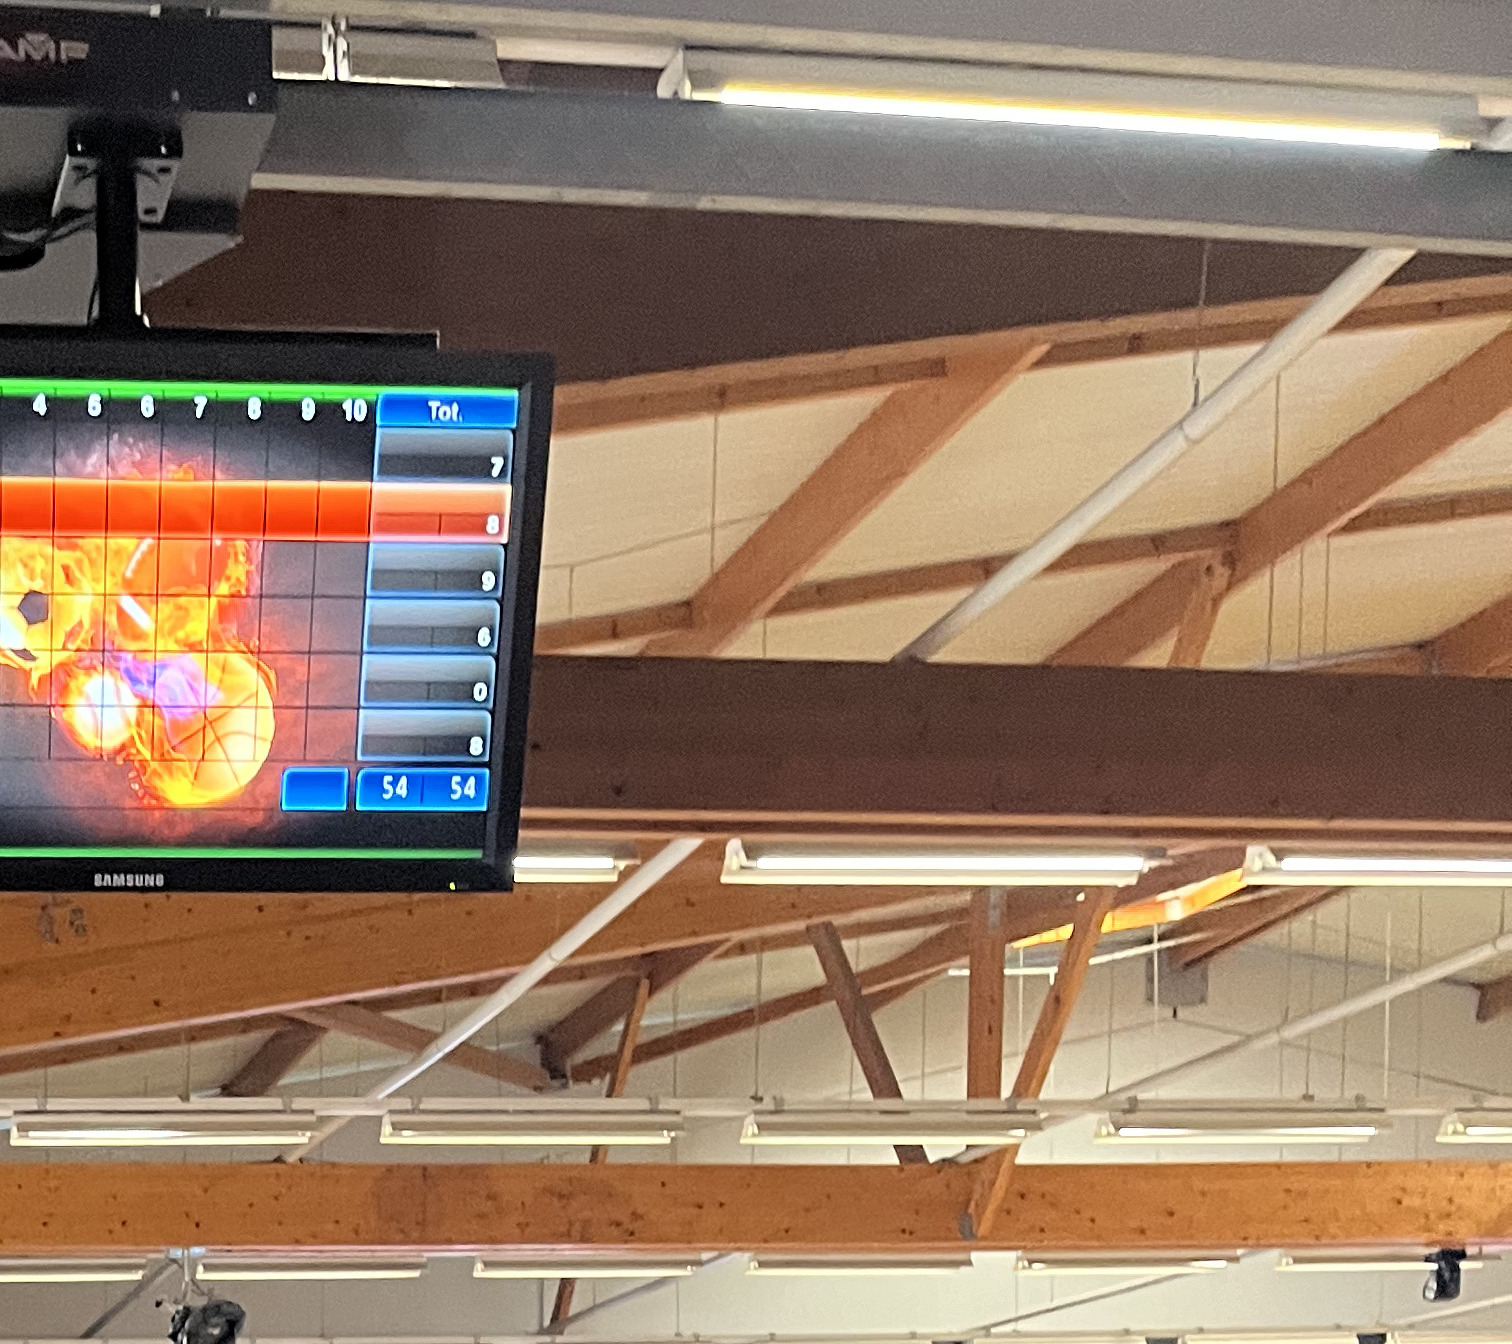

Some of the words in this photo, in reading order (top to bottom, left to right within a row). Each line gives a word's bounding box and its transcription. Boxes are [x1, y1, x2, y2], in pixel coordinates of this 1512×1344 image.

[32, 392, 48, 416] 4
[193, 396, 208, 419] 7
[301, 397, 316, 421] 9
[342, 398, 367, 422] 10
[490, 456, 504, 477] 7
[481, 570, 496, 592] 9
[472, 681, 488, 703] 0
[382, 775, 408, 800] 54
[450, 776, 476, 800] 54
